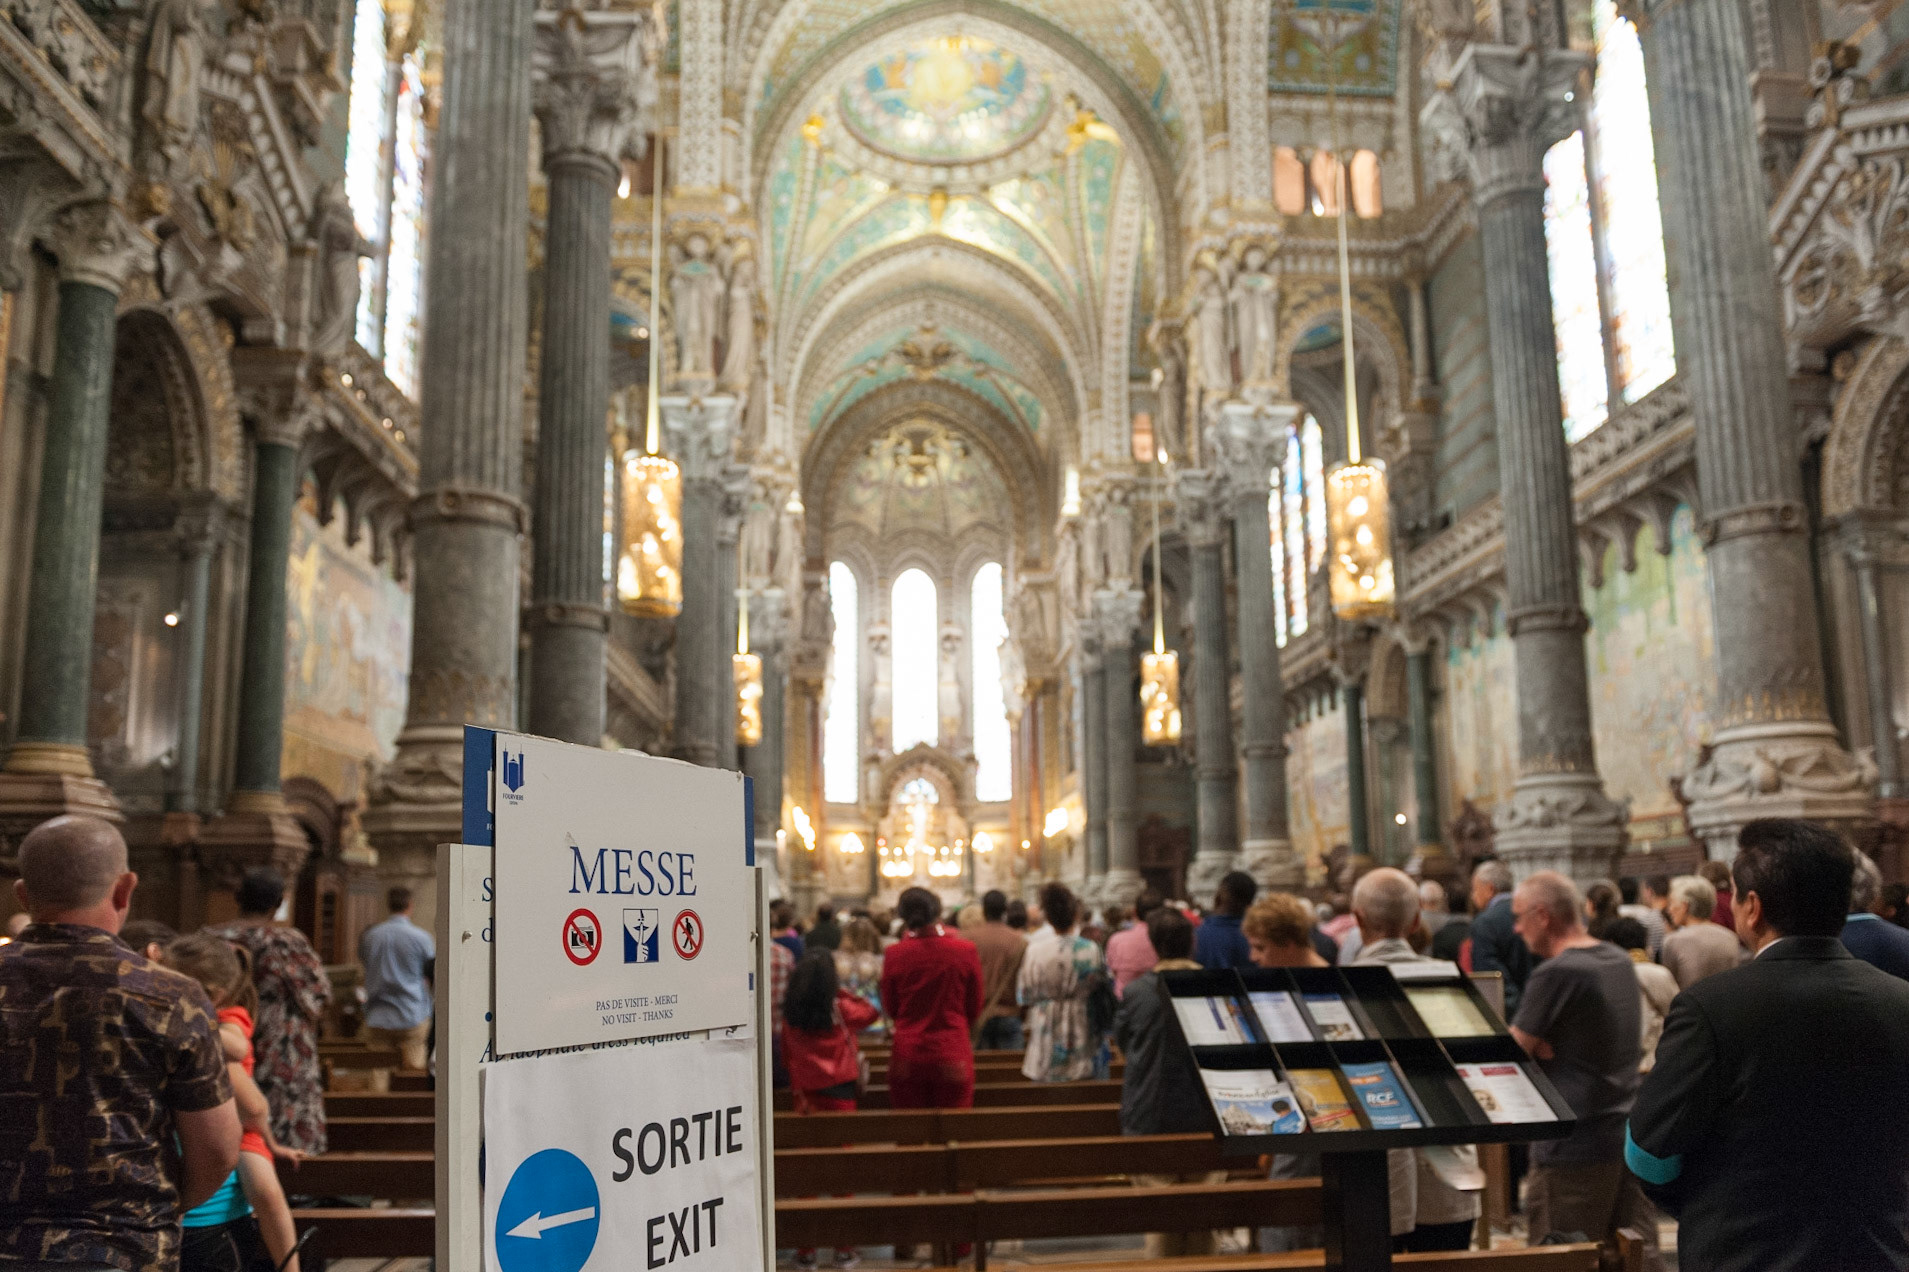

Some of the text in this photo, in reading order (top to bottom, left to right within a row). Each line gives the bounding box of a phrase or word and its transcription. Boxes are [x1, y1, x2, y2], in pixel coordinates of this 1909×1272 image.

[569, 846, 697, 896] MESSE
[596, 1000, 611, 1011] PAS
[612, 999, 623, 1009] DE
[625, 997, 649, 1008] VISITE
[655, 994, 678, 1006] MERCI
[602, 1014, 615, 1026] NO
[616, 1012, 637, 1024] VISIT
[643, 1009, 673, 1022] THANKS
[612, 1105, 743, 1182] SORTIE
[647, 1197, 724, 1270] EXIT
